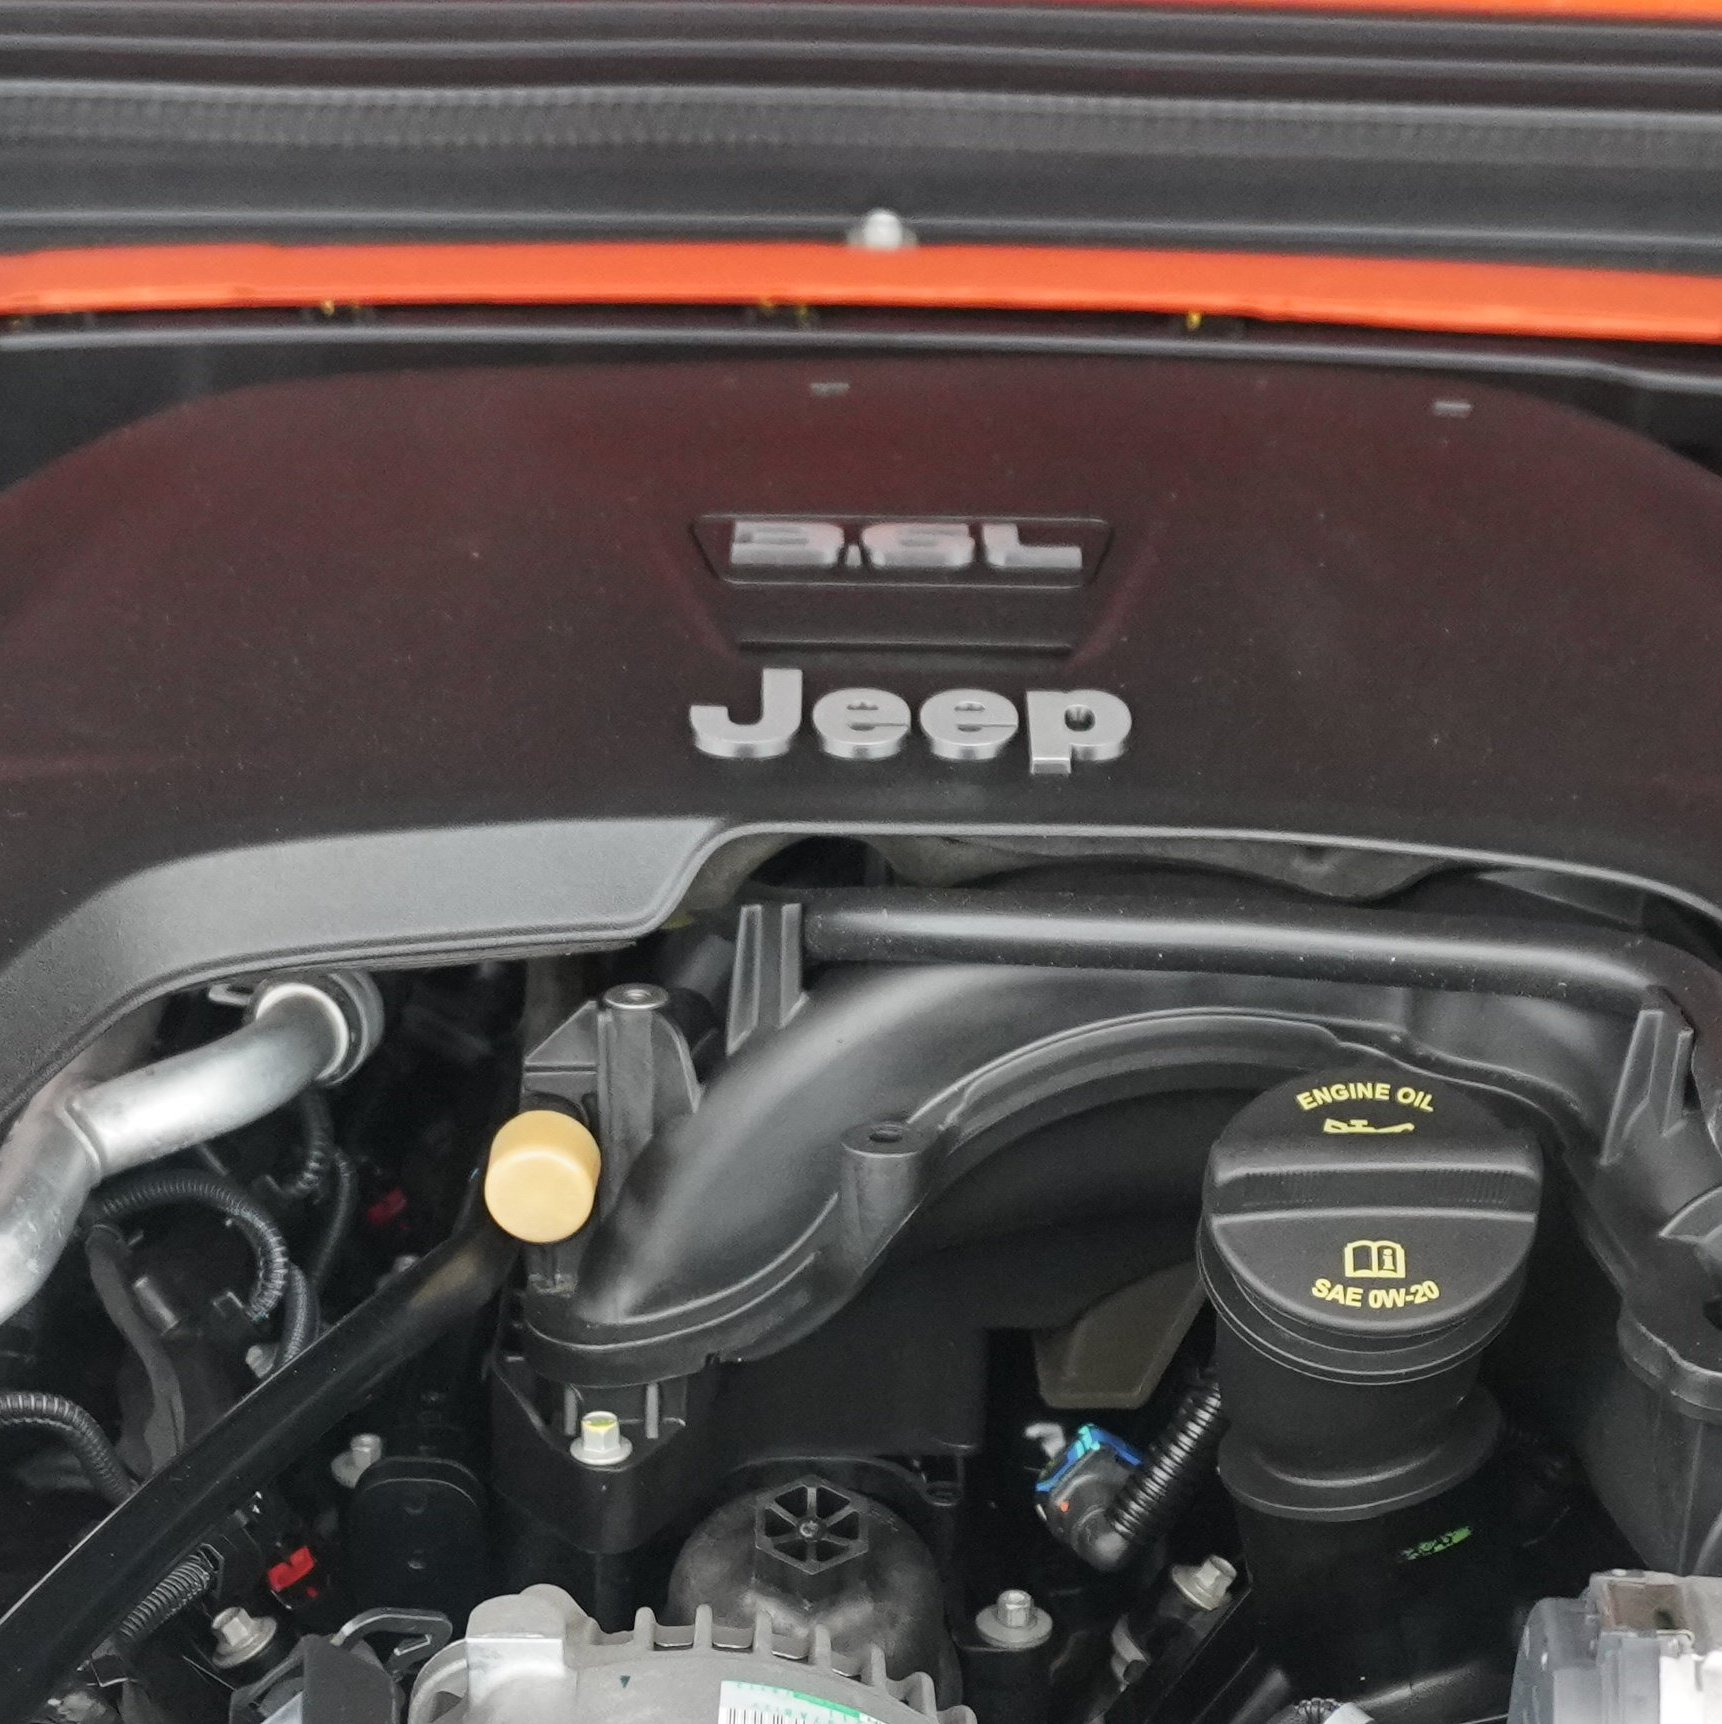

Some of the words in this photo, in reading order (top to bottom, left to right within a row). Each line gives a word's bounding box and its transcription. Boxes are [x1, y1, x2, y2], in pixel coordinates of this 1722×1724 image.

[688, 667, 1134, 776] Jeep
[1295, 1081, 1391, 1112] ENGINE
[1396, 1085, 1437, 1114] OIL
[1310, 1275, 1364, 1308] SAE
[1367, 1279, 1441, 1310] 0W-20
